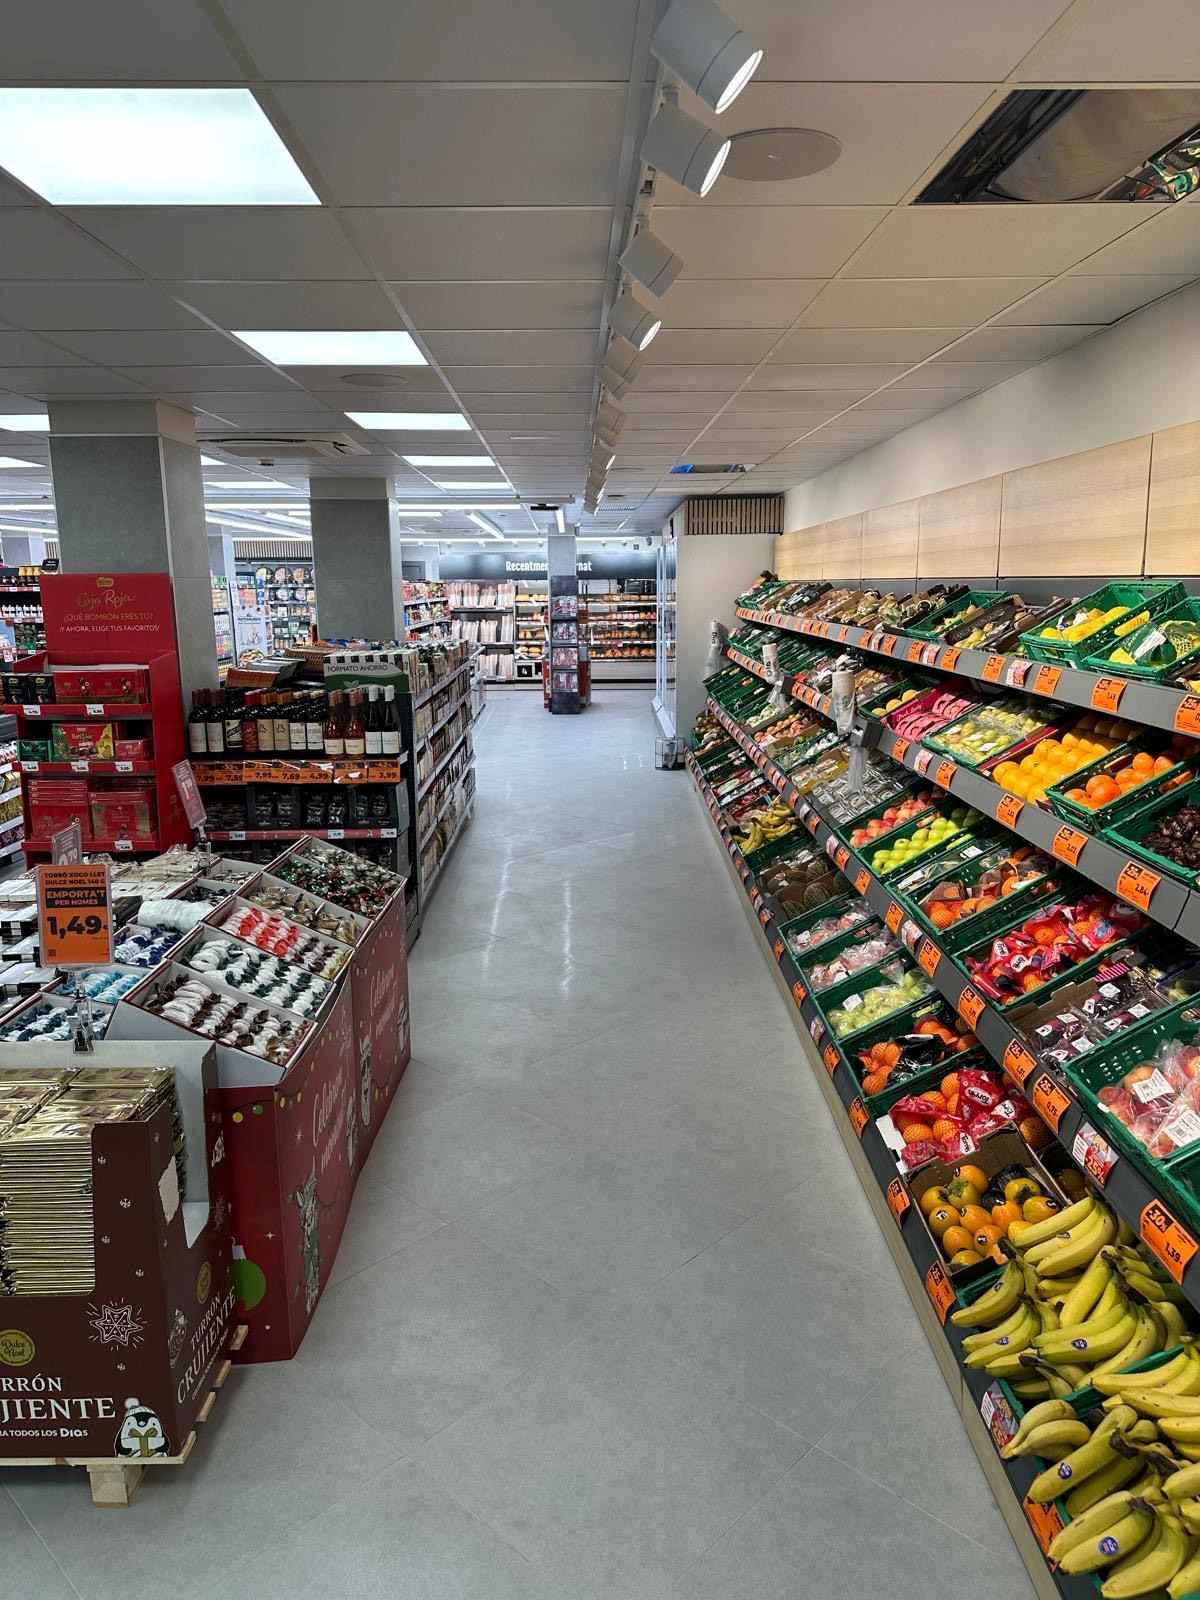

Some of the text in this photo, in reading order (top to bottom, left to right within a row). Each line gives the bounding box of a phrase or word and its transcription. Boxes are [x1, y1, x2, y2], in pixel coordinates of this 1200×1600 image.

[47, 915, 102, 939] 1,49
[9, 1429, 40, 1437] TODOS
[41, 1429, 58, 1437] LOS
